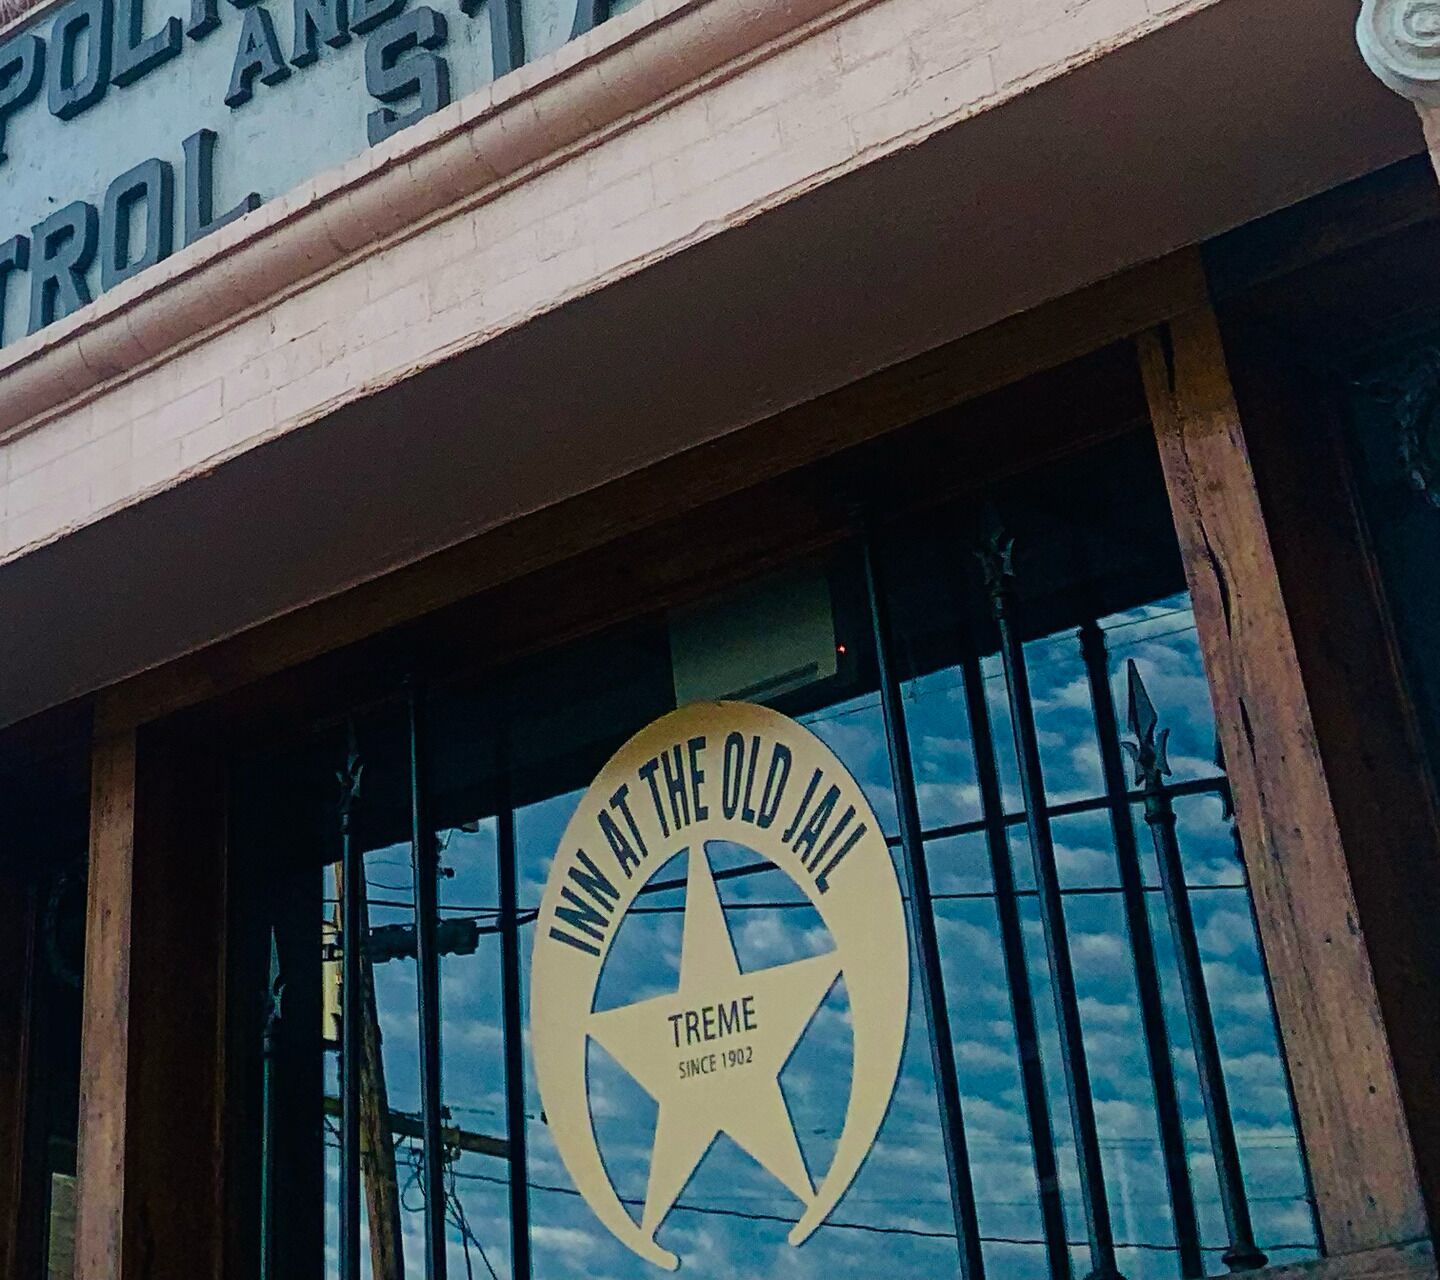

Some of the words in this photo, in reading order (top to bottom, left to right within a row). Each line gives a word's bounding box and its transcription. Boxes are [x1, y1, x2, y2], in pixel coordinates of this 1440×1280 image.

[549, 848, 621, 956] INN
[597, 783, 649, 879] AT
[638, 736, 709, 838] THE
[722, 731, 793, 829] OLD
[781, 767, 867, 895] JAIL
[667, 995, 758, 1048] TREME
[678, 1054, 717, 1079] SINCE
[721, 1046, 753, 1069] 1902
